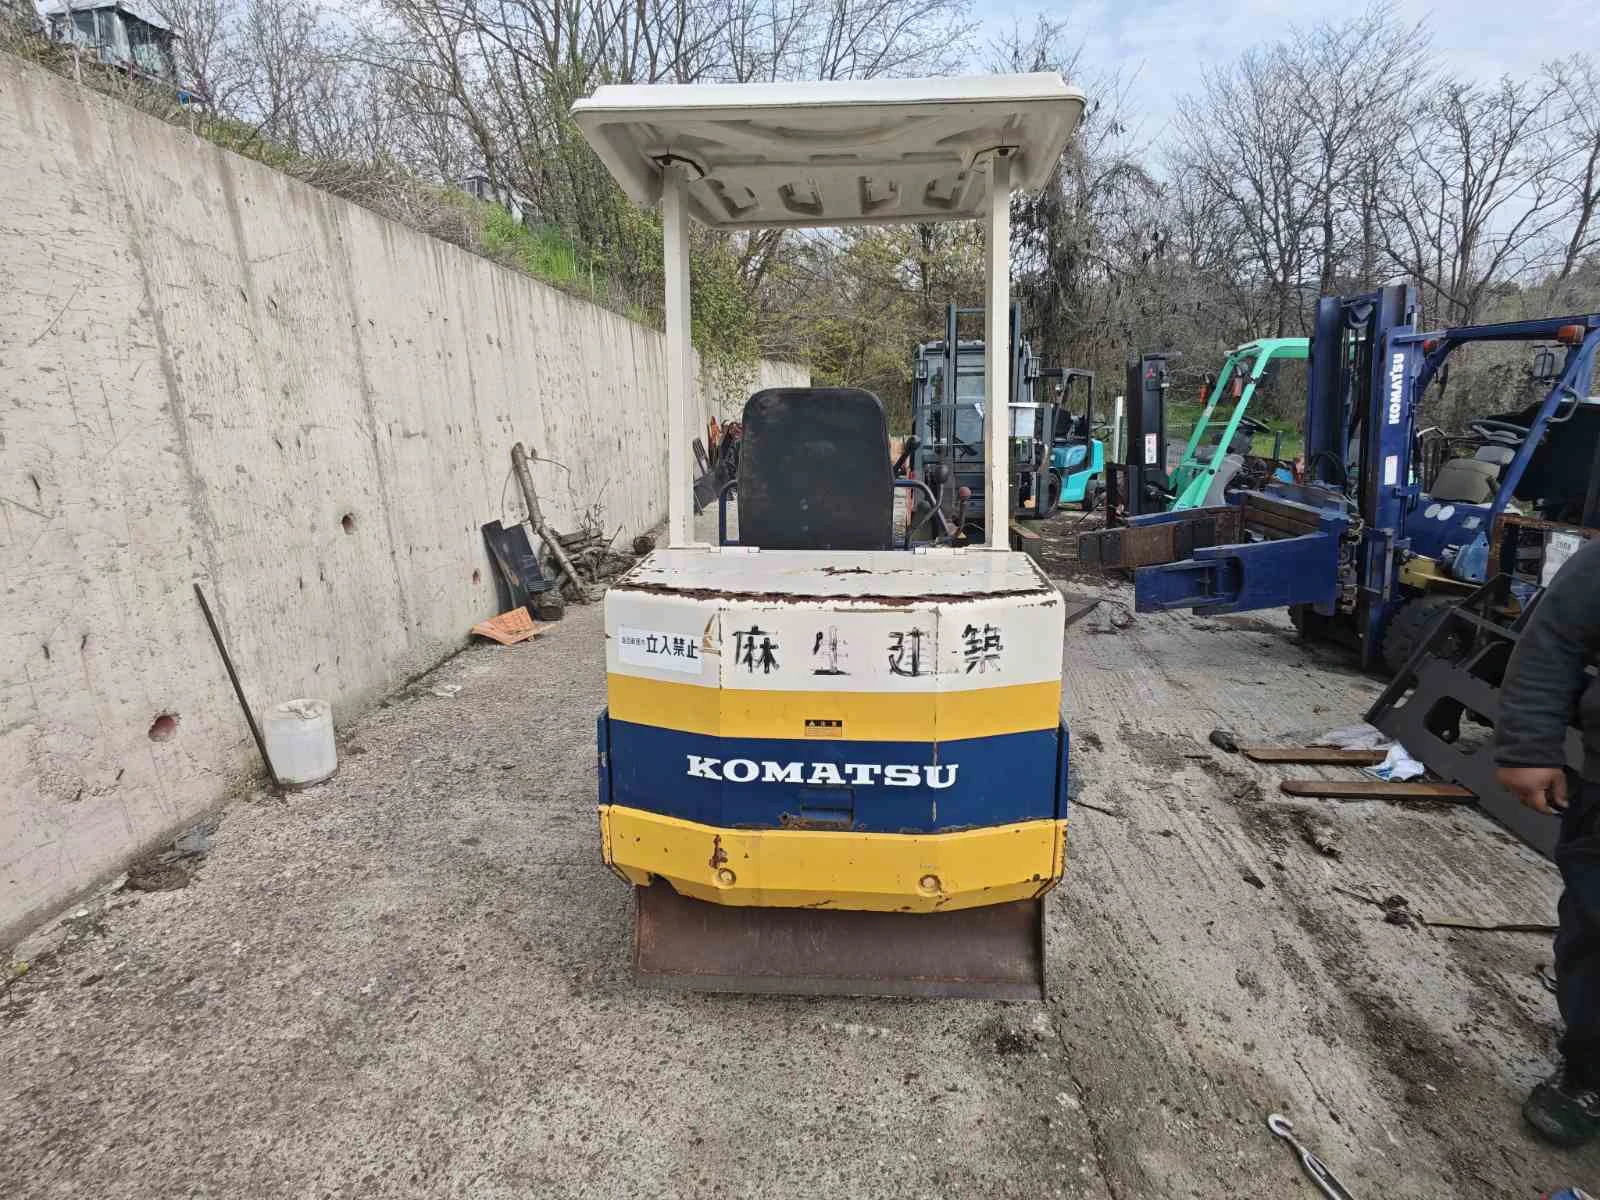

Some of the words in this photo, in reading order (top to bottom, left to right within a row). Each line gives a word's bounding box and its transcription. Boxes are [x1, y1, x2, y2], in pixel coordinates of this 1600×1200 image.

[1388, 353, 1404, 425] KOMATSU
[646, 634, 698, 659] 立入禁止
[687, 754, 958, 789] KOMATSU
